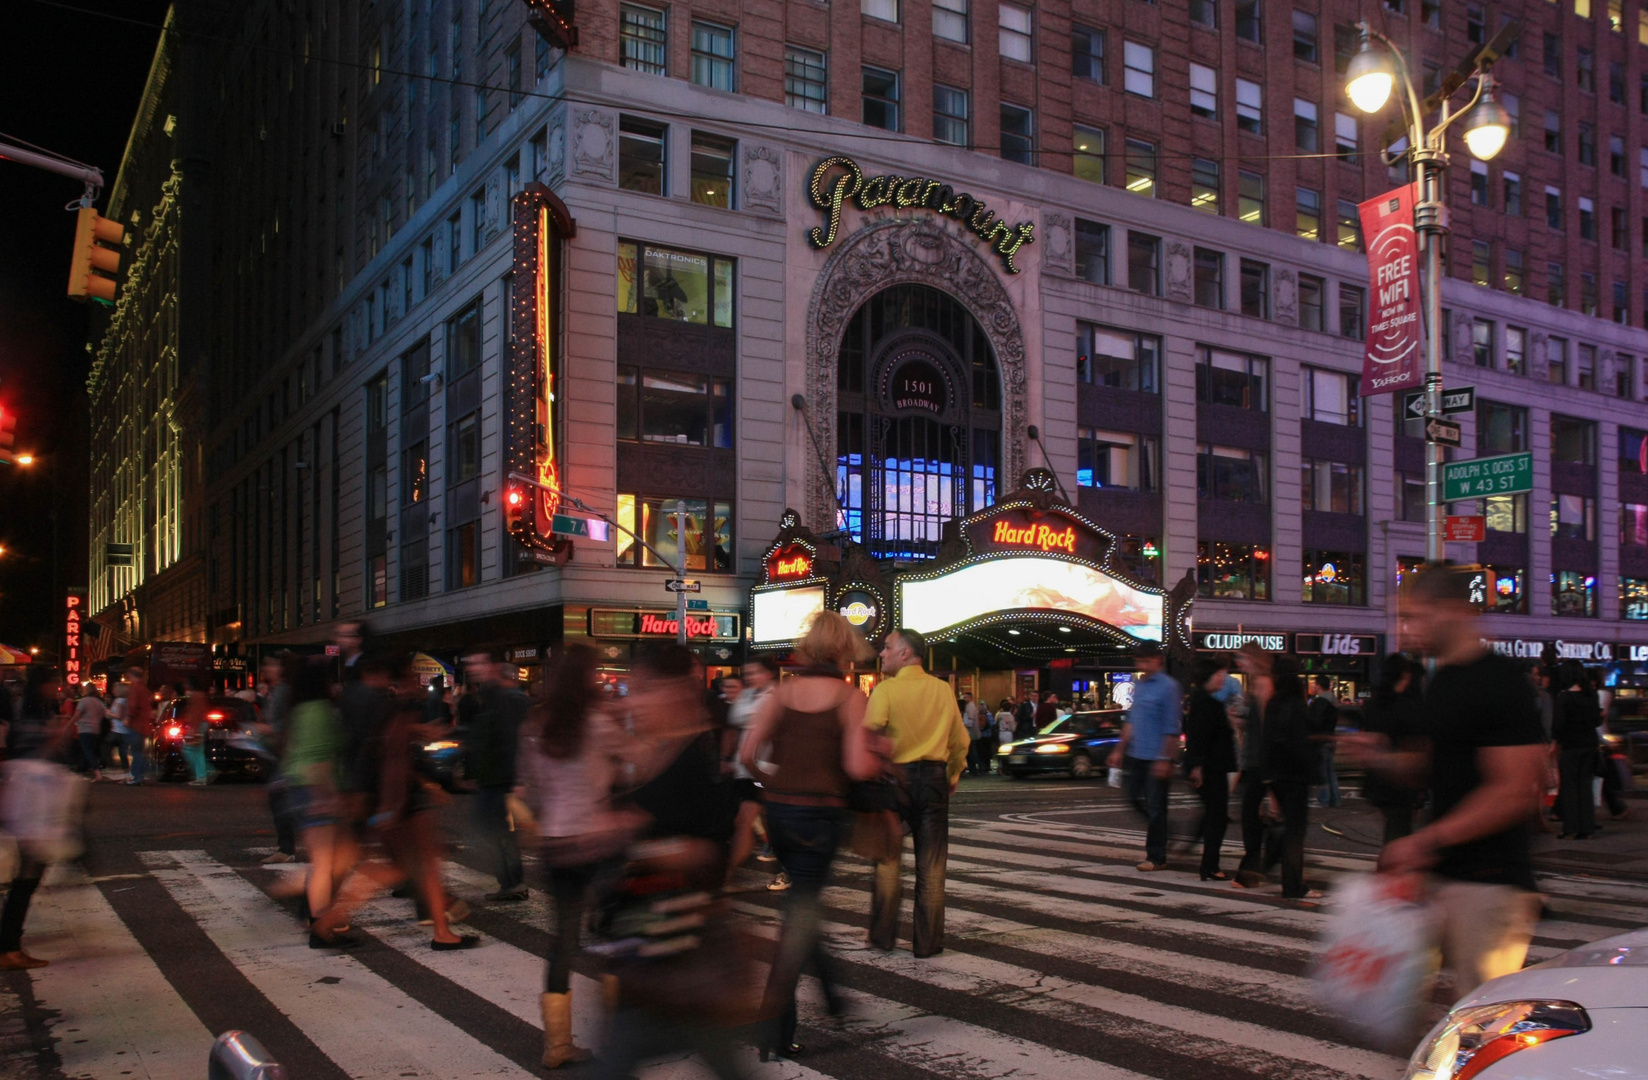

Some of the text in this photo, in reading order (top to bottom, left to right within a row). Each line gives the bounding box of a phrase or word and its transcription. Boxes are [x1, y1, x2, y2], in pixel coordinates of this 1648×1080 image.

[808, 156, 1035, 274] Paramount
[645, 250, 707, 266] DAKTRONICS
[1378, 255, 1411, 286] FREE
[1380, 279, 1409, 307] WIFI
[1382, 303, 1404, 318] NOW IN
[1371, 312, 1417, 334] TIMES SQUARE
[904, 380, 932, 394] 1501
[1371, 371, 1411, 388] YAHOO!
[896, 398, 940, 412] BROADWAY
[1443, 394, 1465, 407] WAY
[1430, 424, 1441, 437] ONE
[1447, 465, 1480, 480] ADOLPH
[1492, 460, 1515, 475] OCHS
[1518, 457, 1529, 471] ST
[1460, 475, 1515, 494] W 43 ST
[570, 521, 577, 532] 7
[994, 521, 1075, 552] Hard Rock
[777, 557, 810, 575] Hard Roc
[840, 605, 876, 617] Hard Rock
[685, 615, 719, 638] Rock
[66, 596, 80, 685] PARKING
[1322, 634, 1361, 655] Lids
[1514, 639, 1544, 658] GUMP
[1555, 639, 1593, 659] SHRIMP
[515, 648, 537, 658] ROCK SHOP
